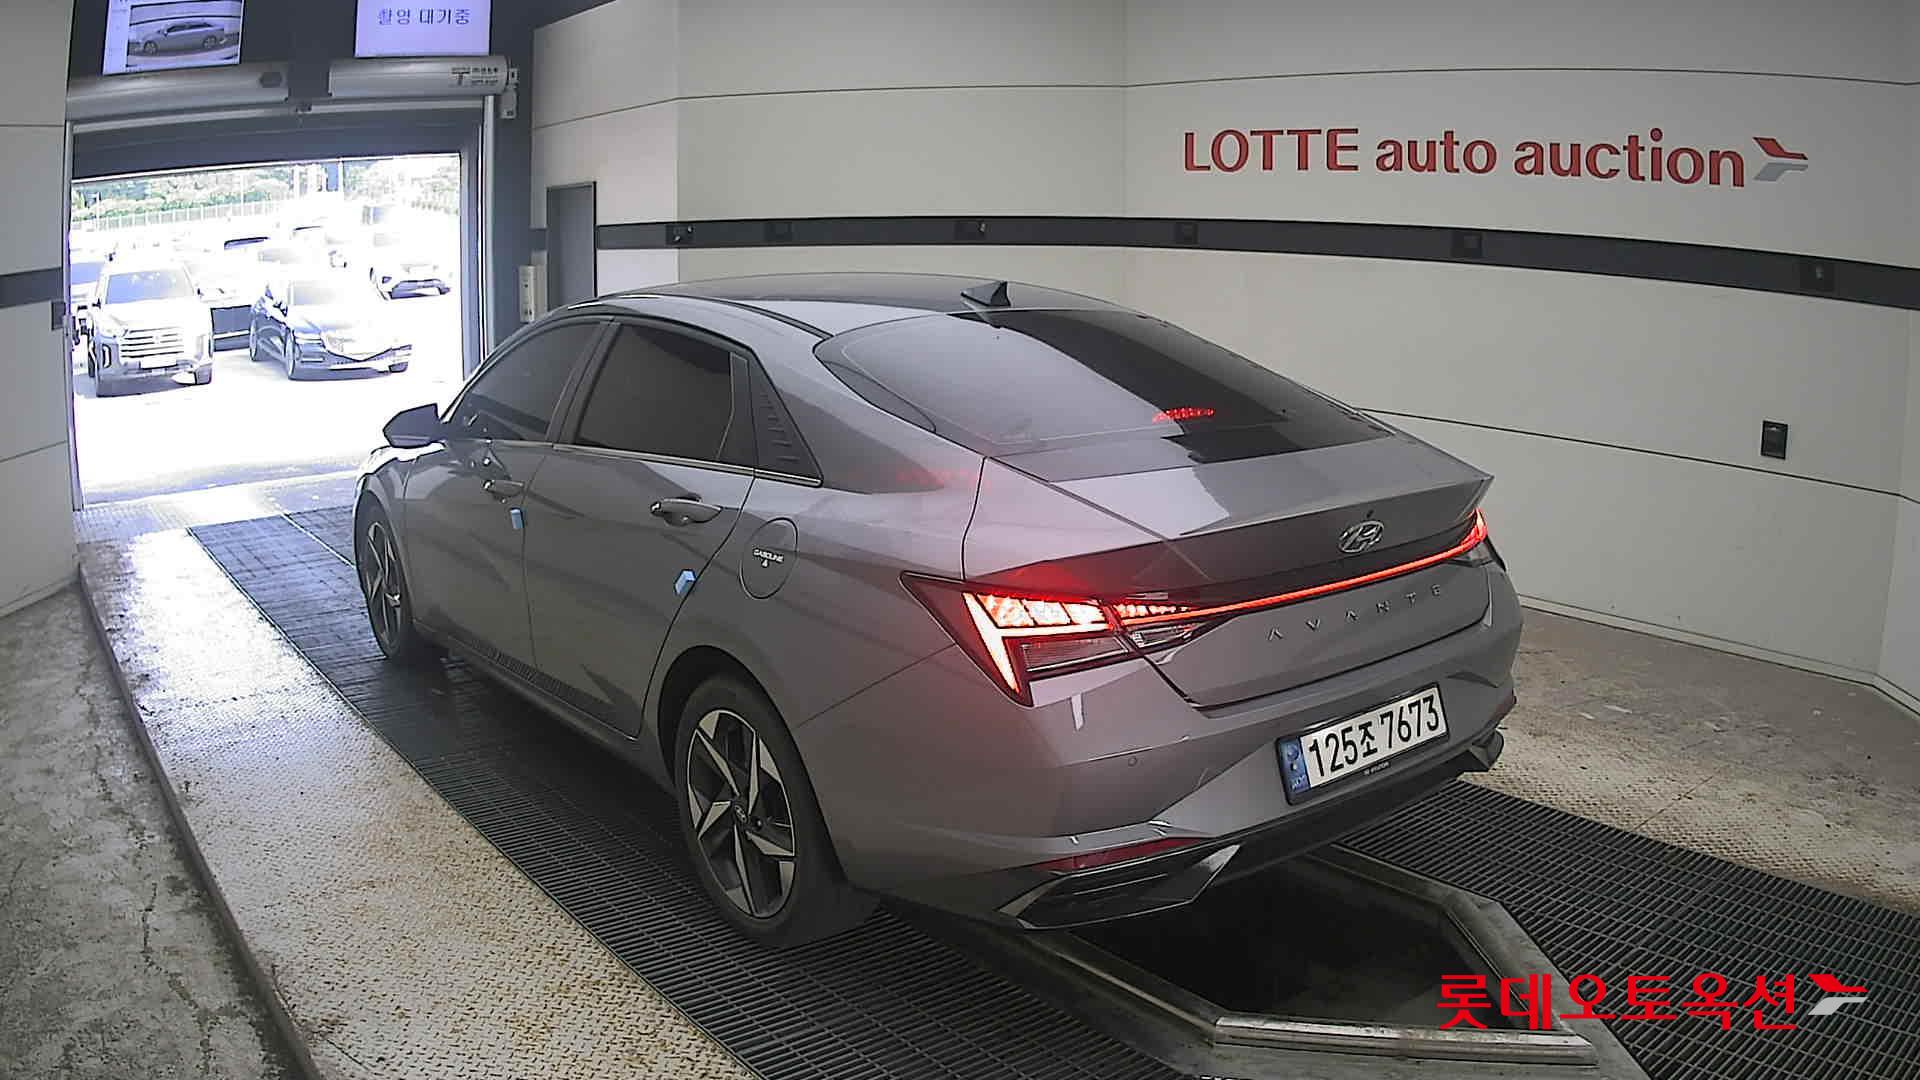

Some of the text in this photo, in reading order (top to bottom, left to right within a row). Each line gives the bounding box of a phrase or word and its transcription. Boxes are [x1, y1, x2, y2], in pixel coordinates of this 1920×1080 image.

[419, 8, 471, 26] 대기중
[1184, 128, 1746, 188] LOTTE auto auction
[1267, 584, 1442, 641] AVANTE
